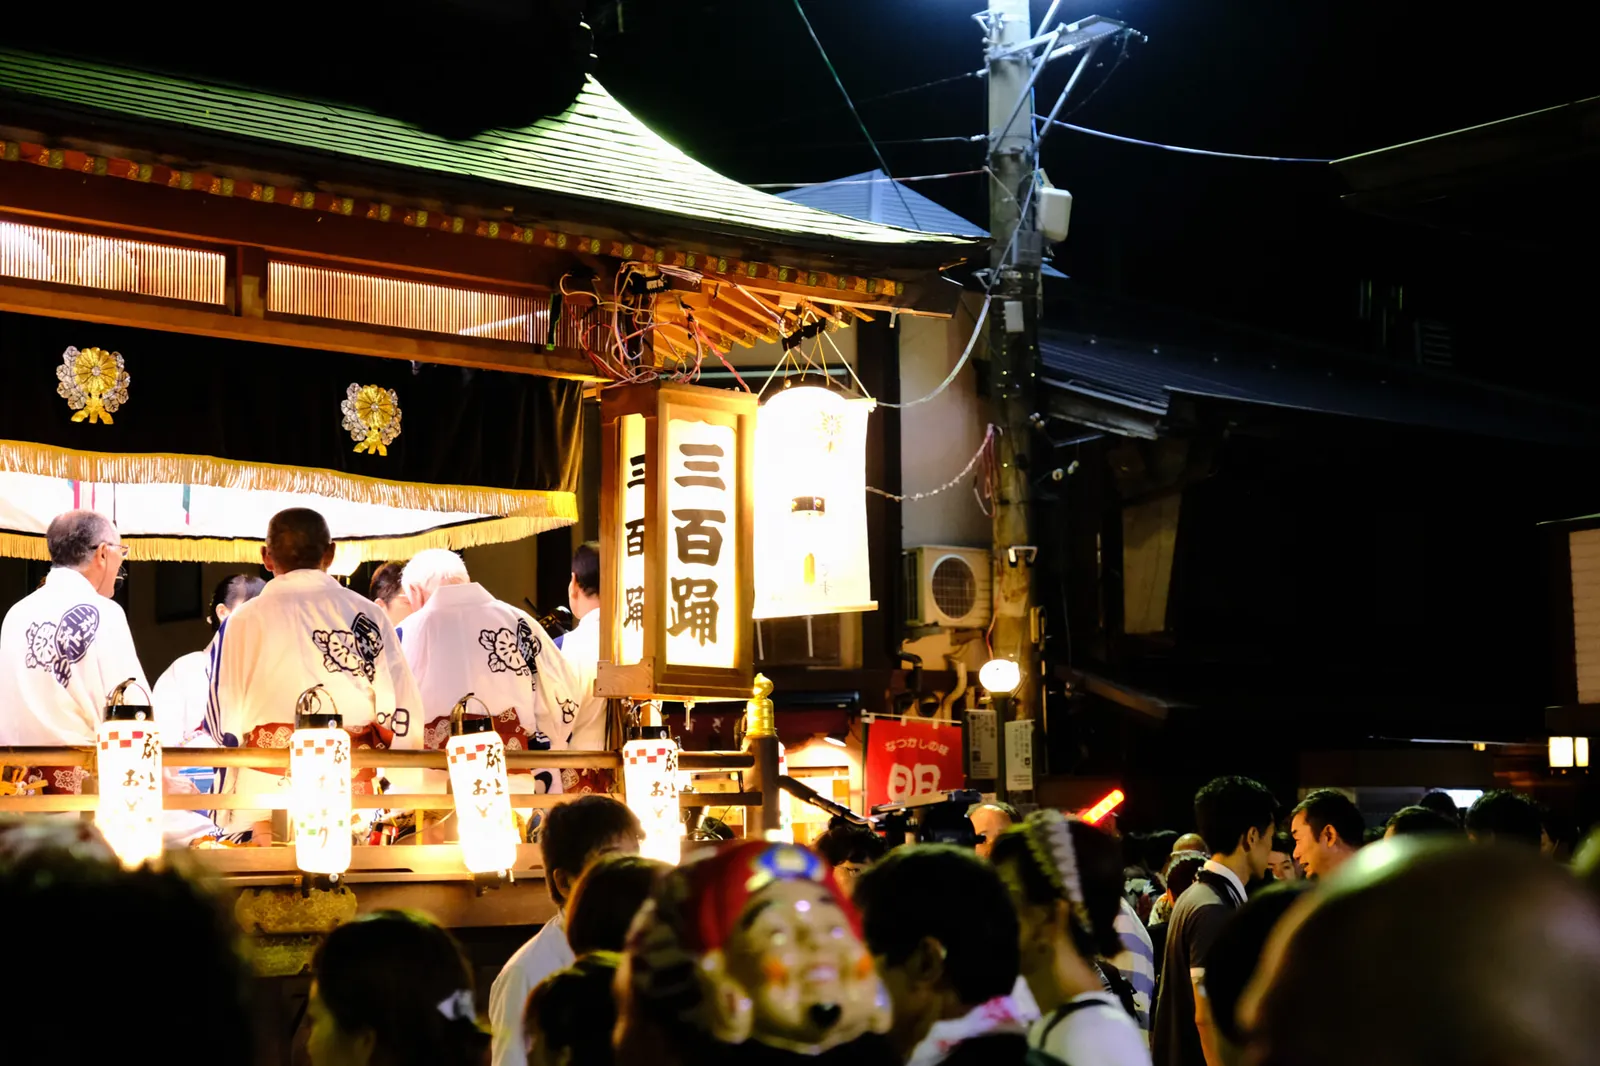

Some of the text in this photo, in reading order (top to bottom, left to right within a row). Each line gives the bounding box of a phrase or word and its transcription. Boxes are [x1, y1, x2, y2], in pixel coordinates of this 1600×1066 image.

[666, 443, 726, 647] 三百踊
[884, 737, 949, 756] なつかしの味
